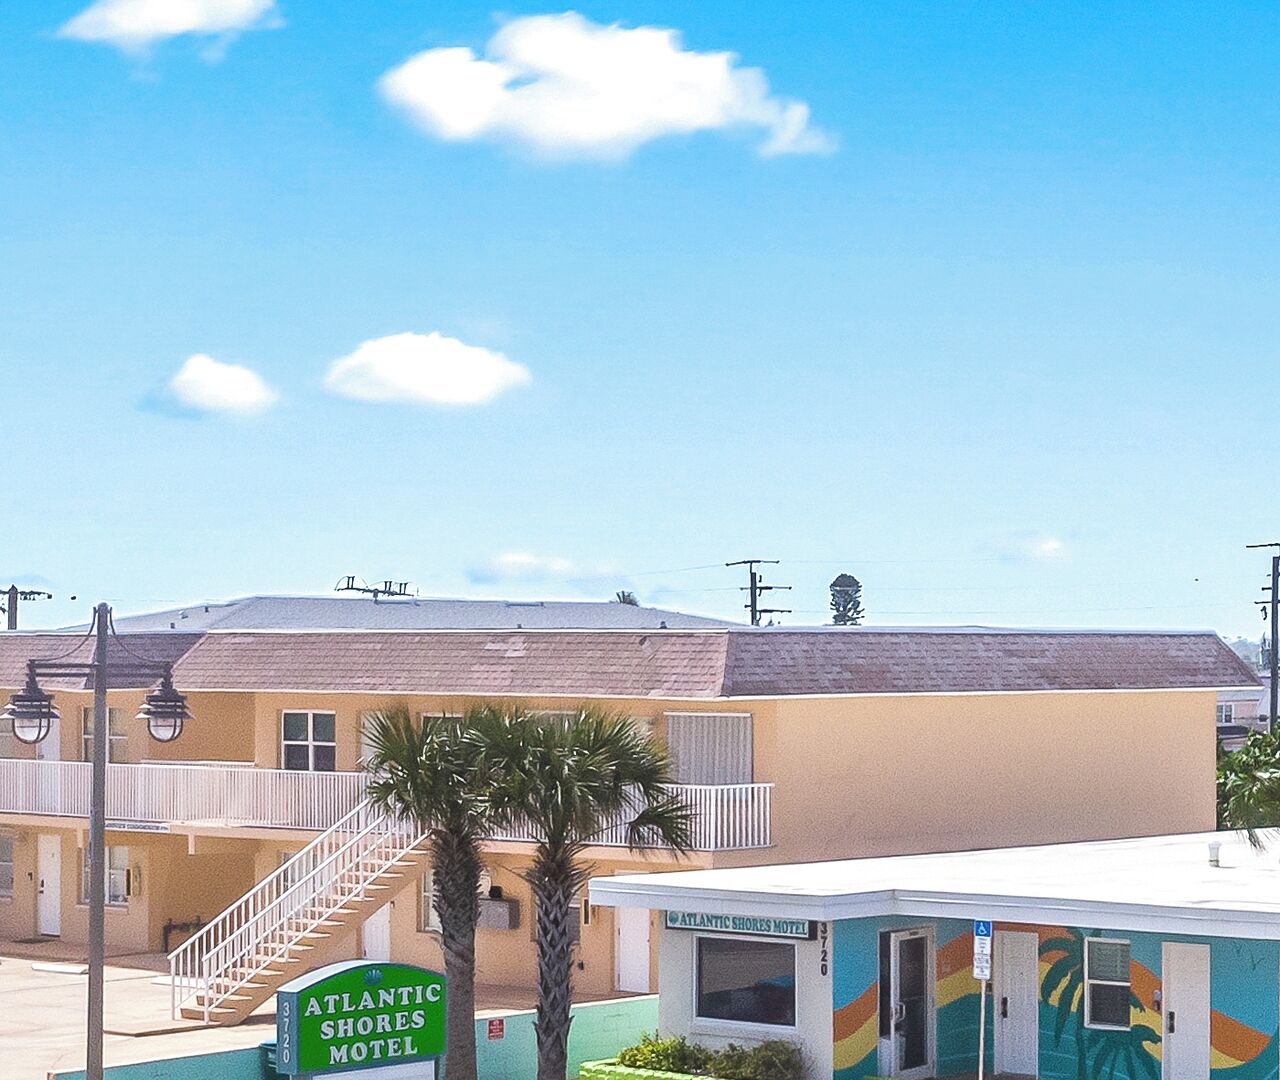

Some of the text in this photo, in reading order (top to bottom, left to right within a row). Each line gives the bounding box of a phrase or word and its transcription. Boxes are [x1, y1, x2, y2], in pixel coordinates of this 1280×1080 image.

[679, 912, 808, 935] ATLANTIC SHORES MOTEL
[820, 922, 828, 976] 3720
[304, 984, 441, 1017] ATLANTIC
[282, 1002, 290, 1063] 3720
[320, 1010, 425, 1040] SHORES
[329, 1036, 418, 1065] MOTEL
